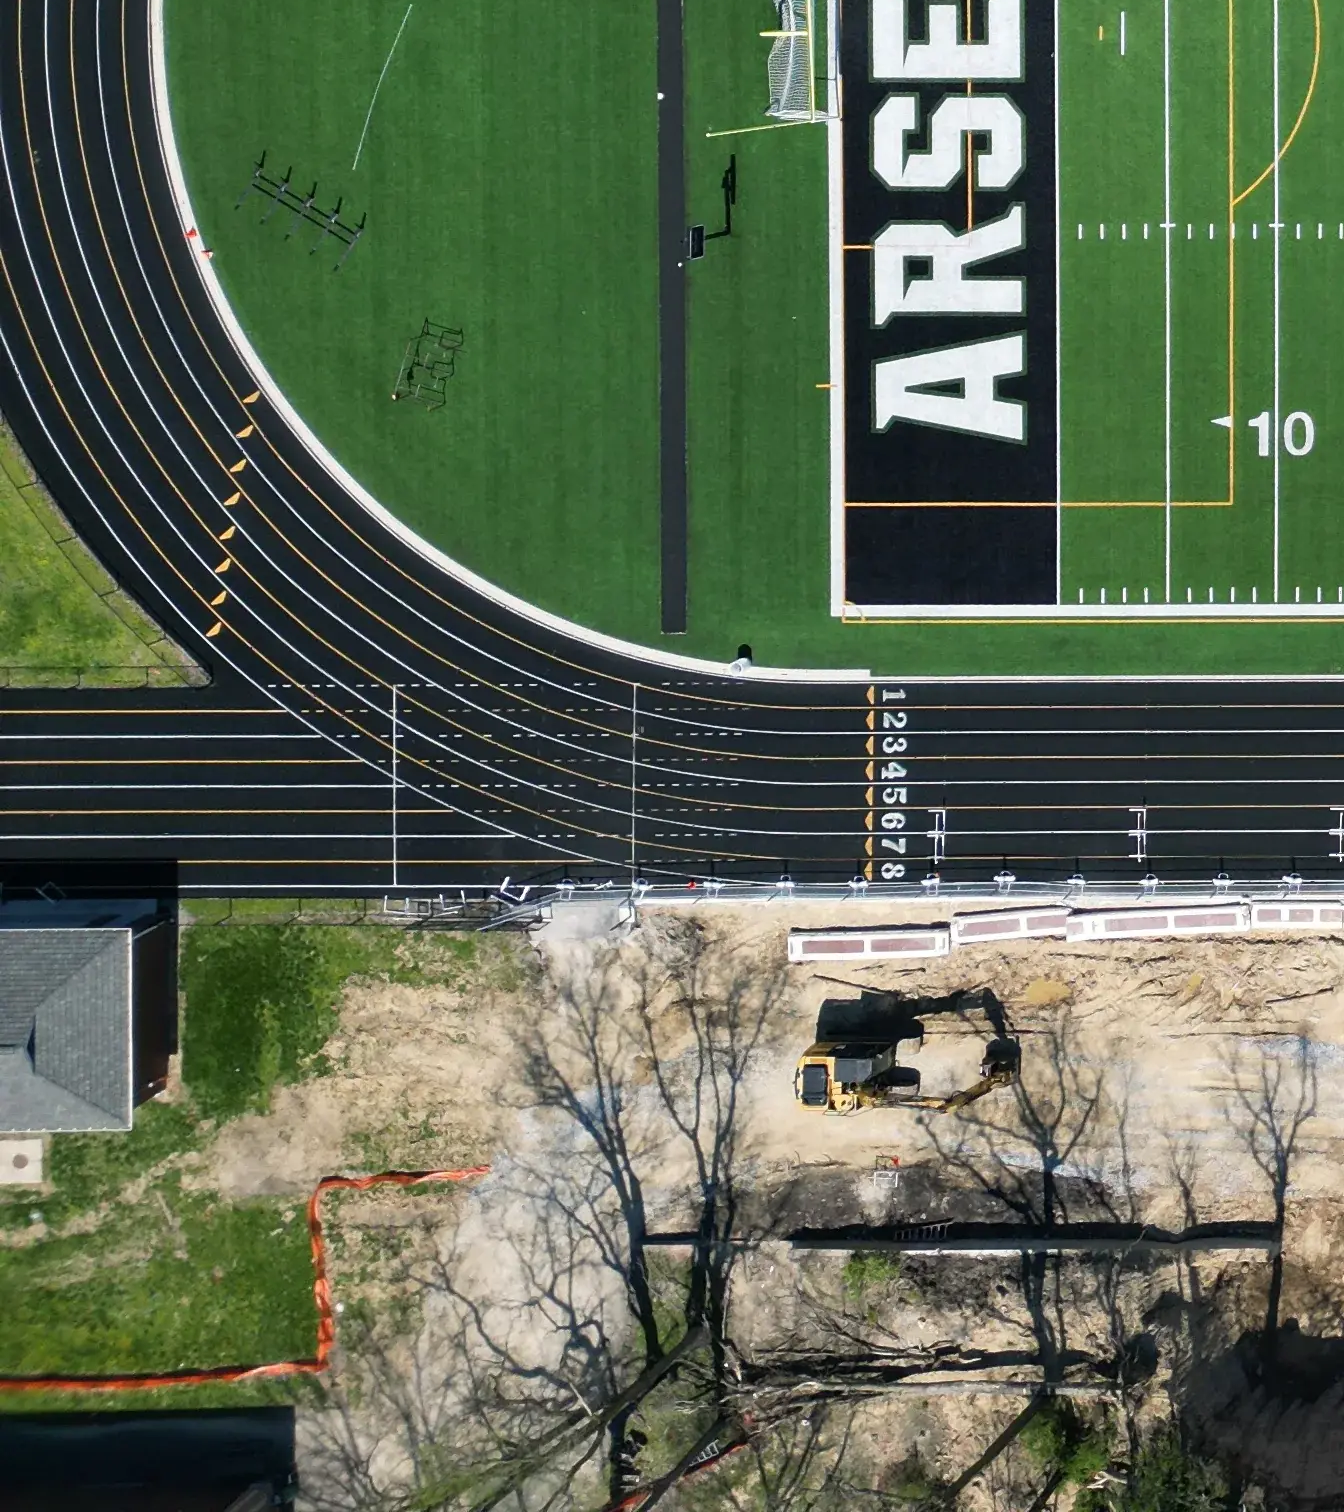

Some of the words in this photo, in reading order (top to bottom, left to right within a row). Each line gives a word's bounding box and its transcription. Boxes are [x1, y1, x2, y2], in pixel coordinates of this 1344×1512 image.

[1248, 411, 1315, 457] 10
[882, 688, 907, 703] 1
[882, 711, 908, 729] 2
[882, 736, 908, 754] 3
[880, 761, 908, 780] 4
[882, 786, 908, 805] 5
[880, 811, 907, 830] 6
[881, 837, 907, 855] 7
[880, 862, 906, 880] 8
